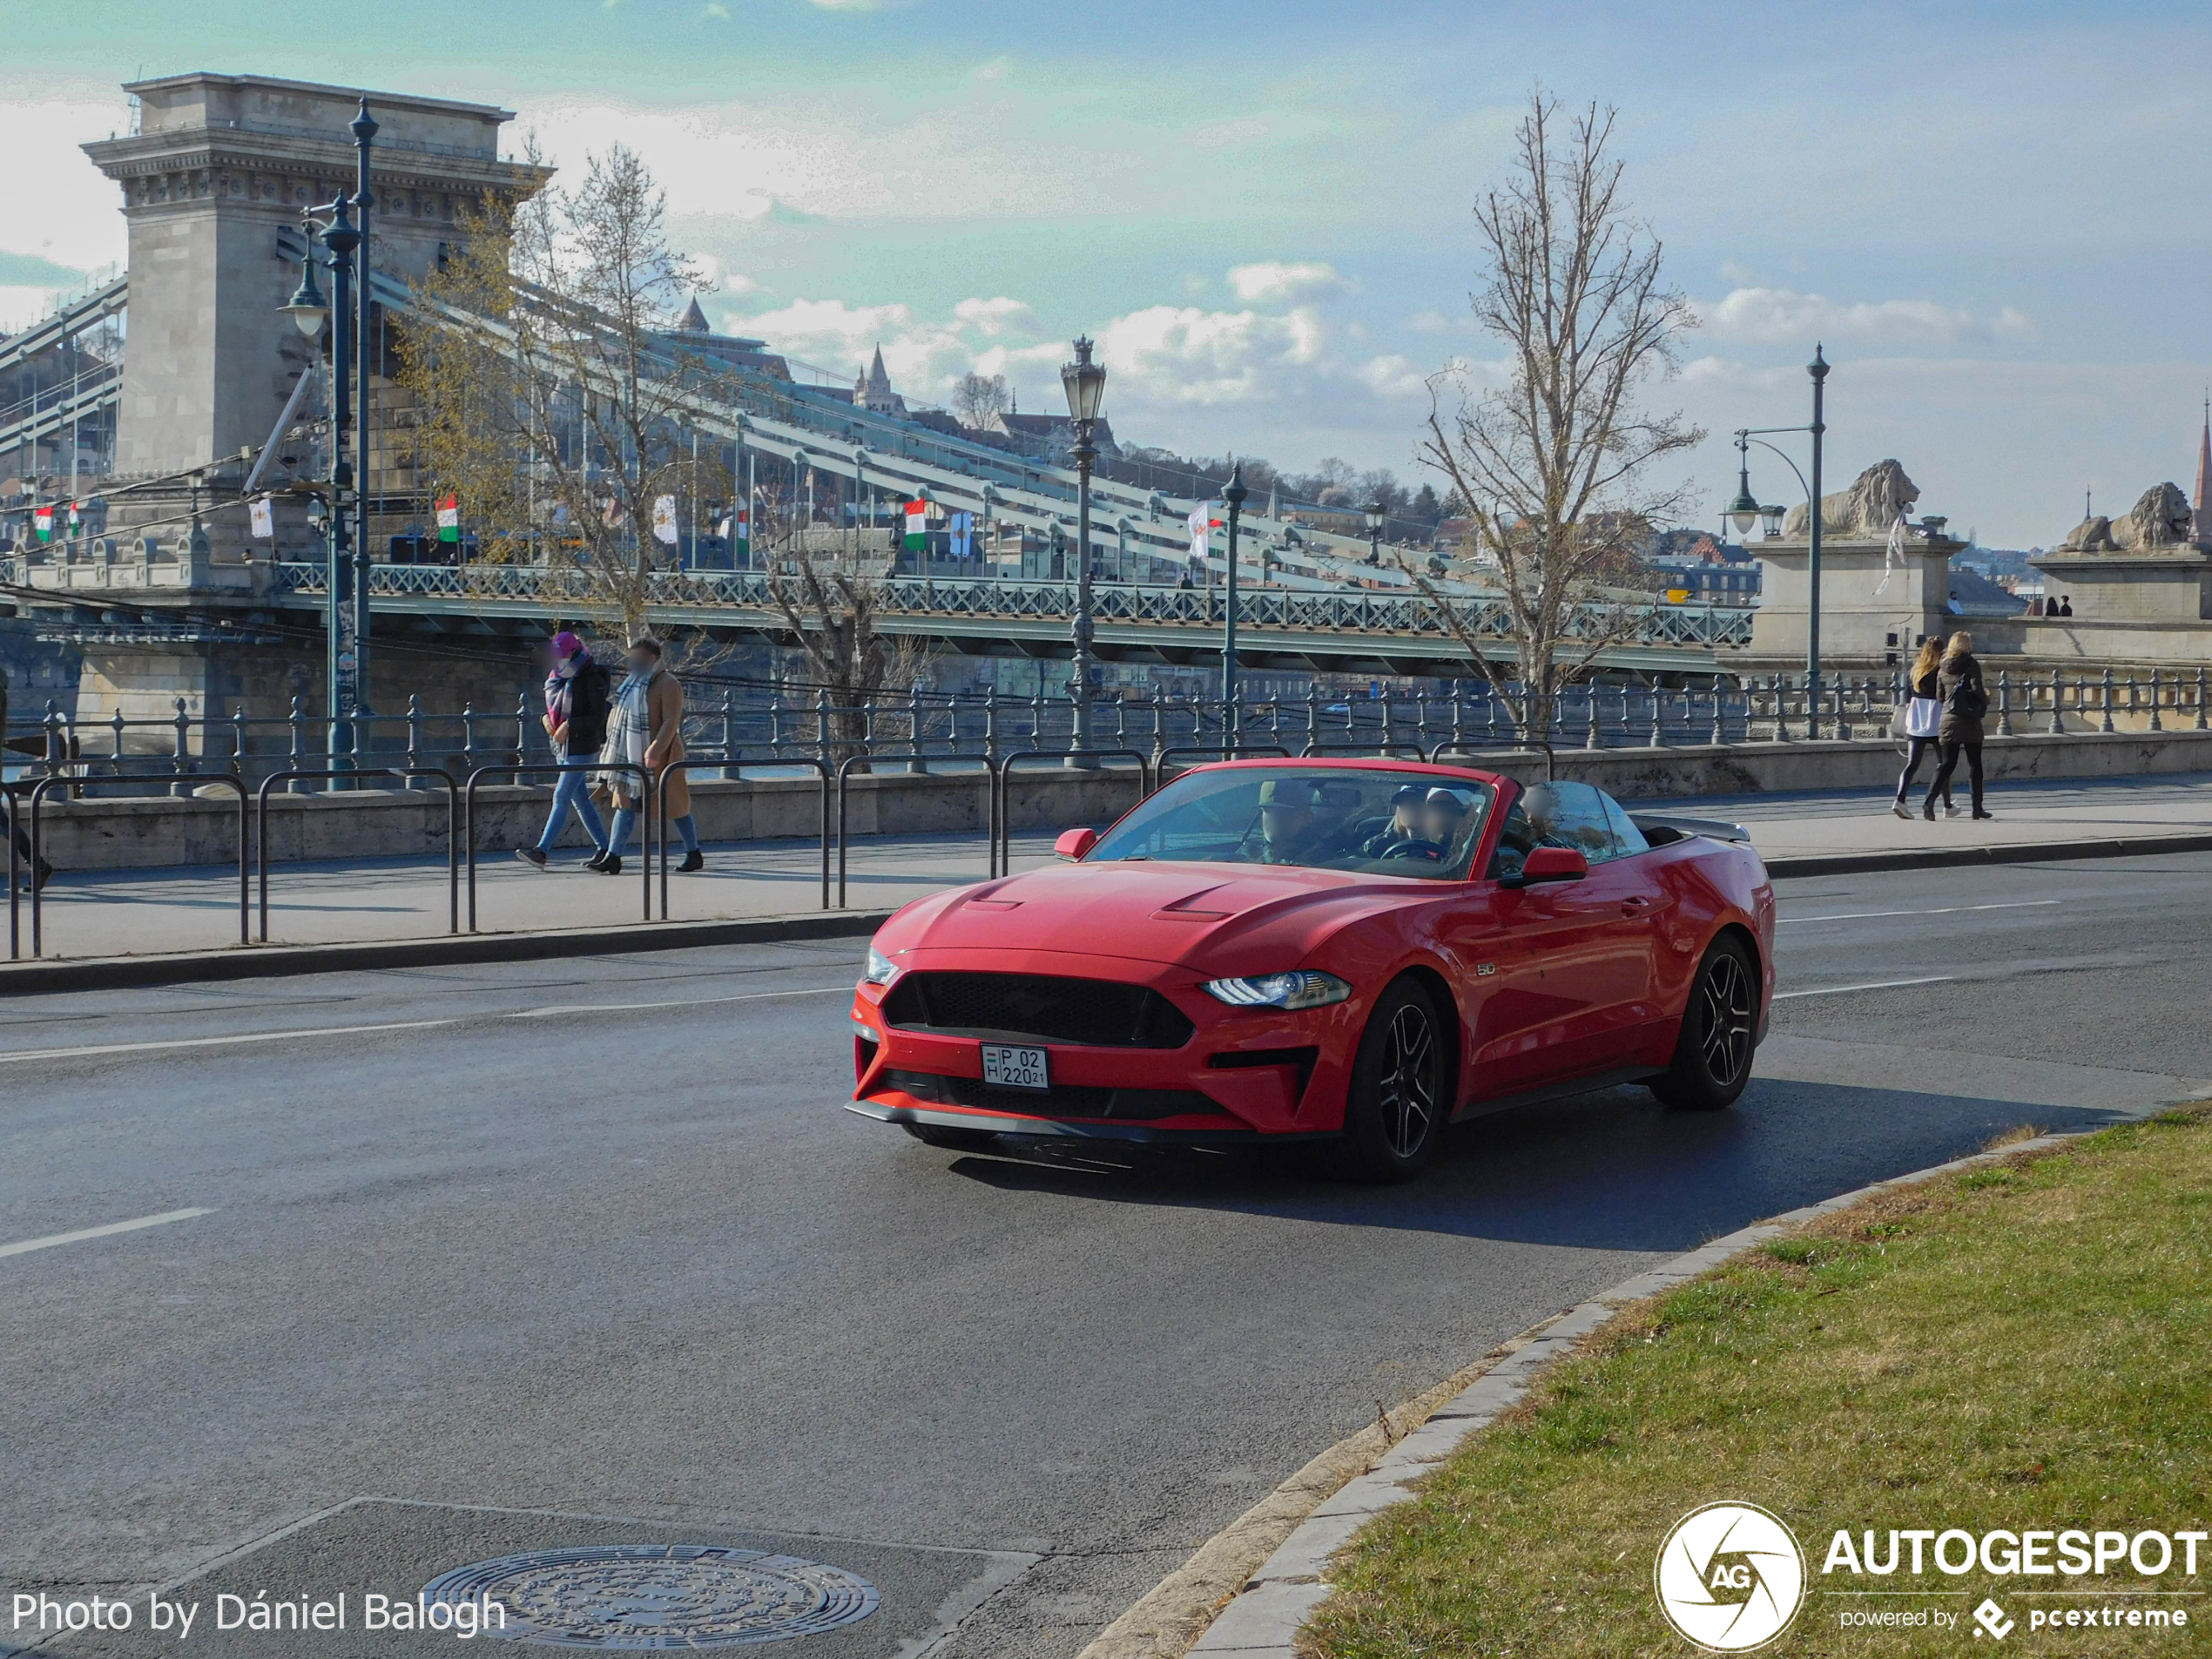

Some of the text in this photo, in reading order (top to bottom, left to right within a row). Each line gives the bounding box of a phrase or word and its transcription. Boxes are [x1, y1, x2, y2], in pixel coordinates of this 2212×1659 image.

[1001, 1049, 1039, 1068] P 02
[987, 1065, 998, 1077] H
